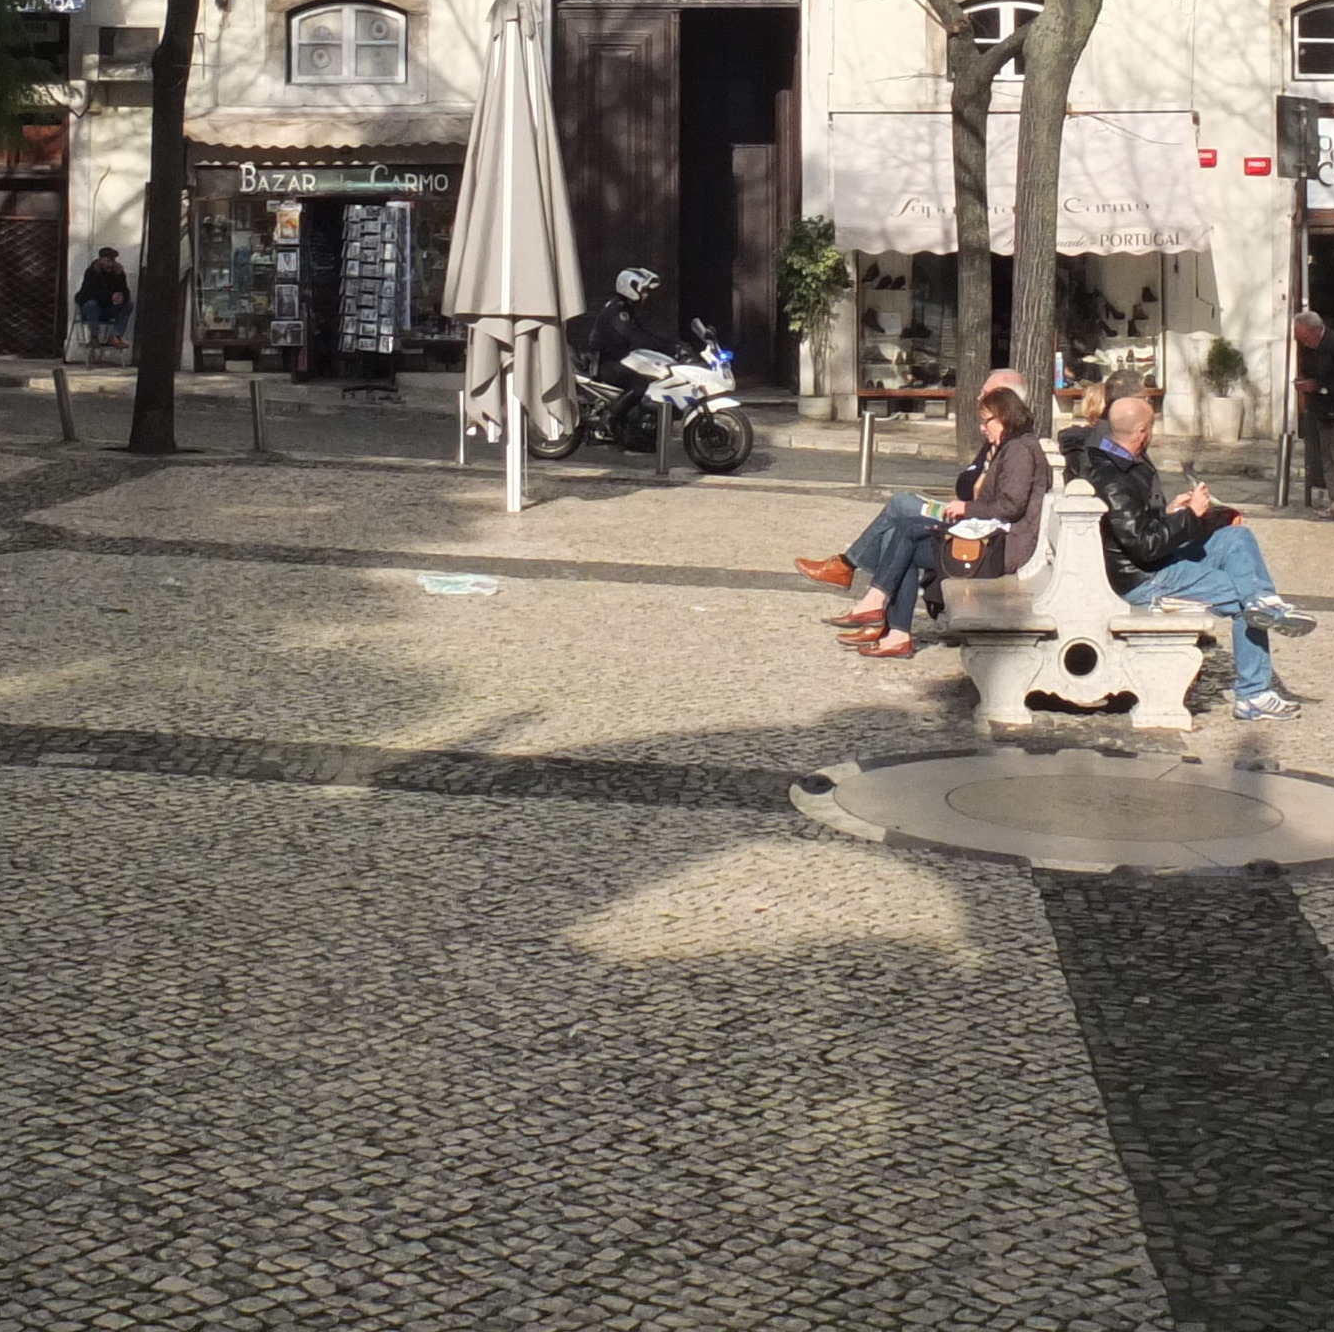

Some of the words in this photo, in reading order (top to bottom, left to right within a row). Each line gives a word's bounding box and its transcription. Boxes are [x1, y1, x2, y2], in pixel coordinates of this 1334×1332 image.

[239, 164, 317, 193] BAZAR
[369, 164, 449, 192] CARMO
[1063, 197, 1151, 214] Carmo
[1100, 232, 1184, 248] PORTUGAL
